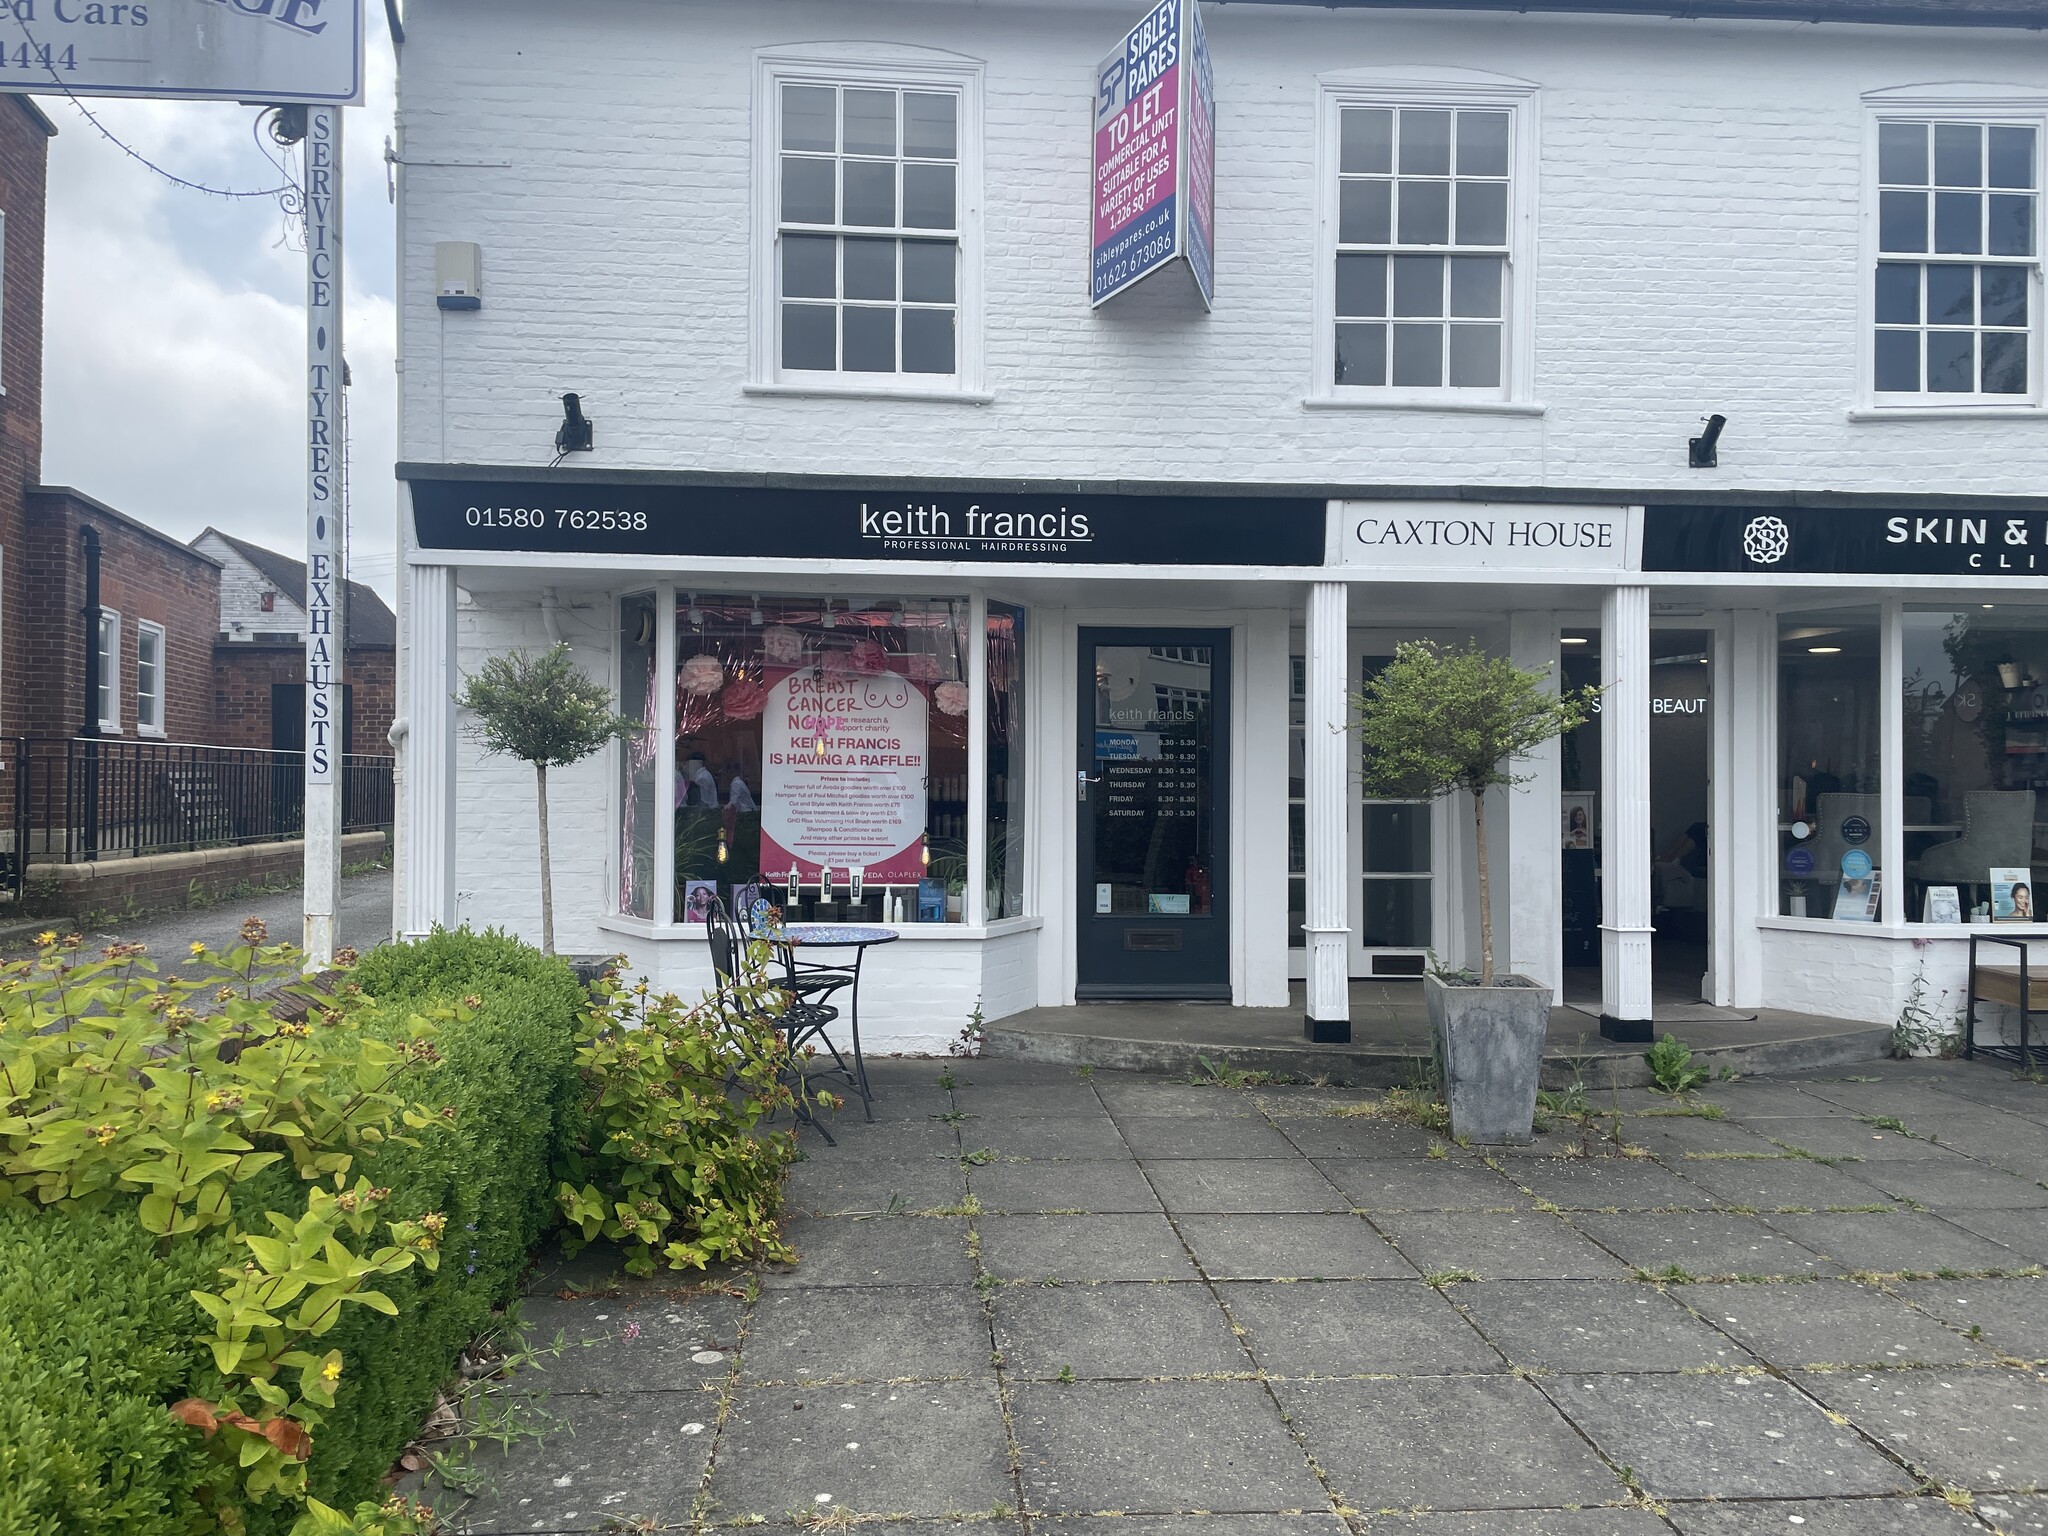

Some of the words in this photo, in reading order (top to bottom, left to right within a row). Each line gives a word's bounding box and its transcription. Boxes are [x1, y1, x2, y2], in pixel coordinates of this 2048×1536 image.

[54, 0, 149, 27] Cars
[1129, 0, 1177, 64] SIBLEY
[1128, 32, 1177, 100] PARES
[1108, 112, 1129, 153] TO
[1132, 82, 1164, 136] LET
[1098, 131, 1150, 182] COMMERCIAL
[1151, 107, 1175, 138] UNIT
[1102, 158, 1139, 199] SUITABLE
[1141, 146, 1159, 166] FOR
[1160, 136, 1168, 152] A
[1100, 183, 1133, 219] VARIETY
[1134, 173, 1146, 192] OF
[1147, 154, 1170, 183] USES
[312, 115, 331, 307] SERVICE
[1110, 206, 1131, 232] 1,226
[1132, 195, 1145, 215] SQ
[1144, 183, 1157, 204] FT
[1096, 207, 1170, 268] sibleypares.co.uk
[1096, 259, 1127, 294] 01622
[1130, 231, 1171, 275] 673086
[310, 365, 331, 501] TYRES
[465, 506, 545, 528] 01580
[554, 509, 648, 531] 762538
[860, 503, 950, 535] keith
[1356, 519, 1495, 546] CAXTON
[1508, 522, 1612, 548] HOUSE
[1886, 516, 1987, 544] SKIN
[2004, 519, 2028, 545] &
[884, 540, 971, 550] PROFESSIONAL
[981, 542, 1067, 552] HAIRDRESSING
[309, 554, 331, 774] EXHAUSTS
[788, 677, 859, 694] BREAST
[787, 696, 863, 712] CANCER
[1109, 708, 1143, 720] keith
[1653, 698, 1707, 714] BEAUT
[837, 738, 901, 750] FRANCIS
[865, 724, 890, 733] charity
[769, 753, 783, 764] IS
[786, 754, 842, 765] HAVING
[846, 755, 856, 765] A
[860, 755, 921, 767] RAFFLE!!
